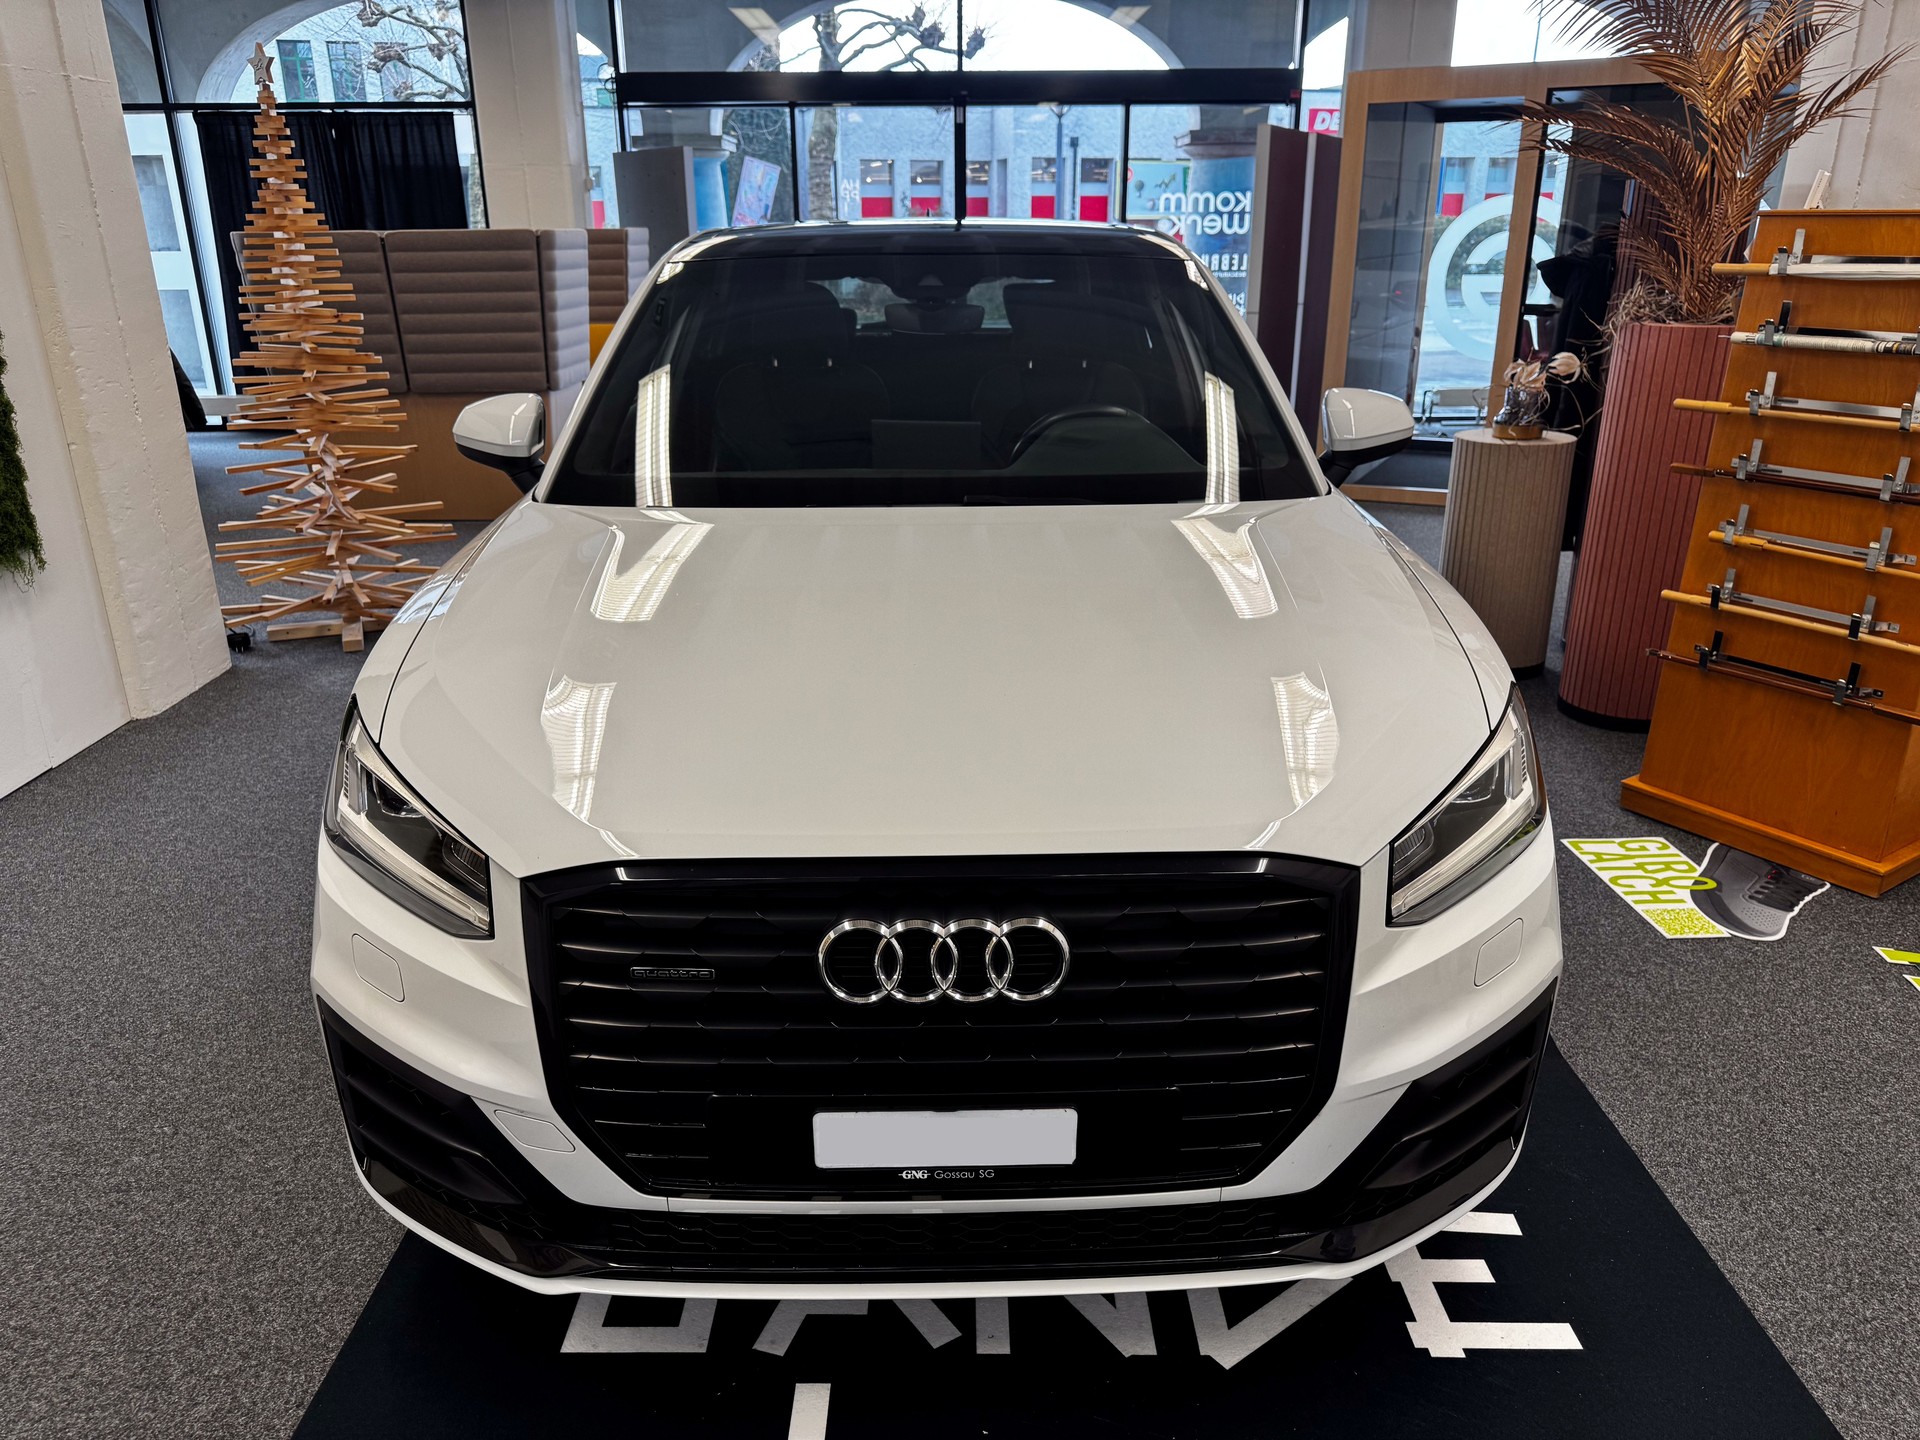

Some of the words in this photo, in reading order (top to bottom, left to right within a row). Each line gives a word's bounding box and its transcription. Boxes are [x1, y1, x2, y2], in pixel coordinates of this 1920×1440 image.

[1616, 838, 1719, 891] GIRO
[634, 969, 711, 978] quattro
[934, 1170, 975, 1179] Gossau
[979, 1169, 995, 1179] SG
